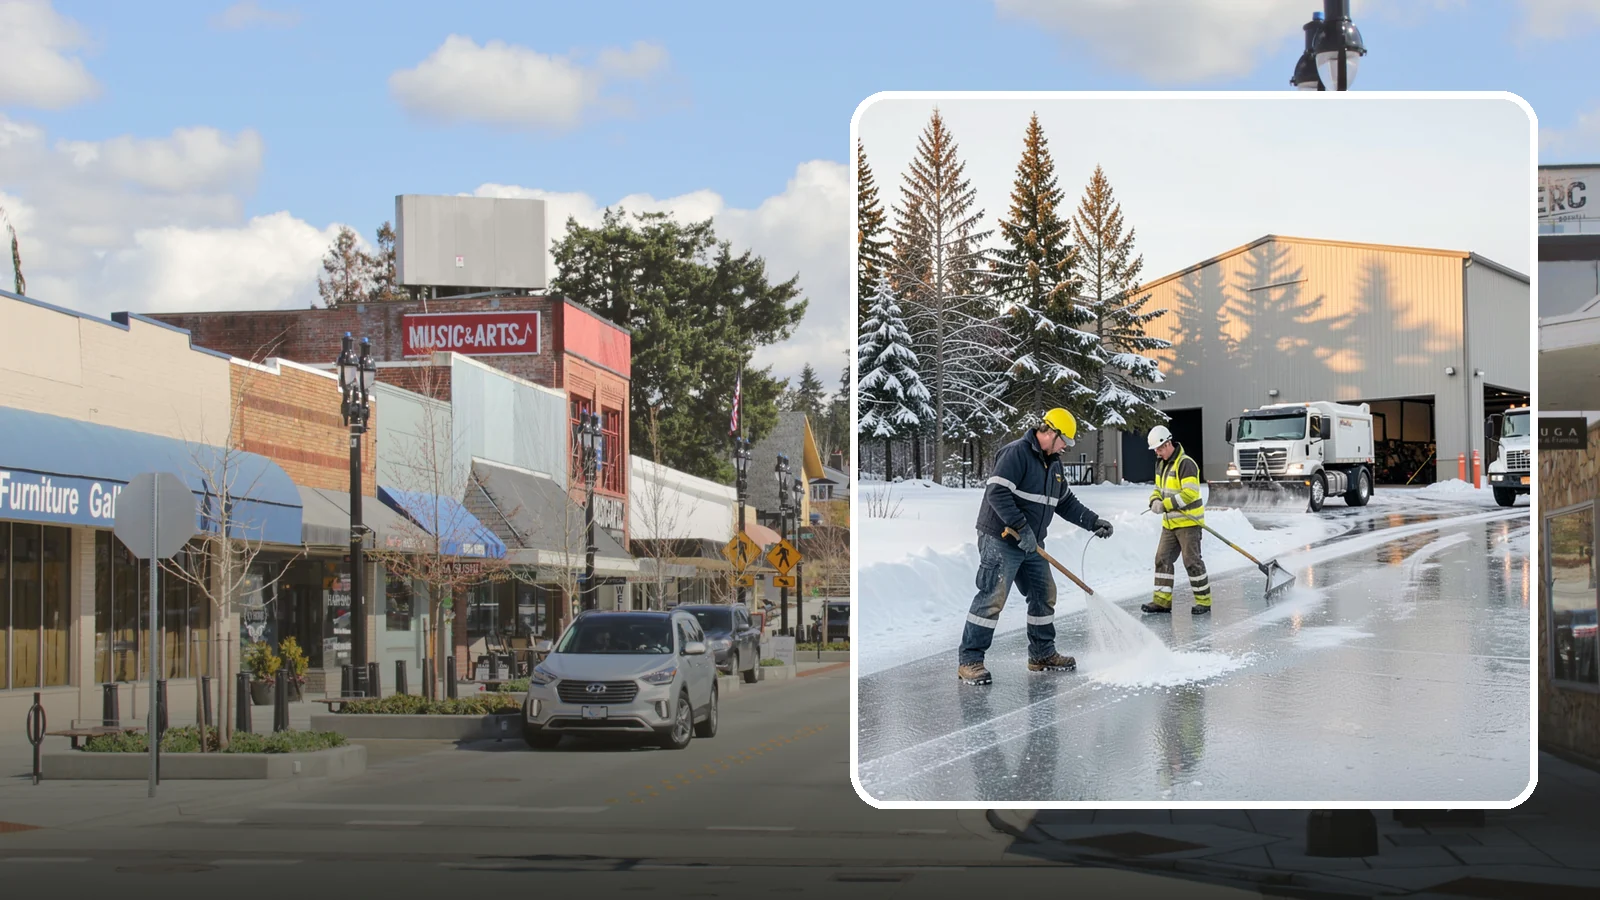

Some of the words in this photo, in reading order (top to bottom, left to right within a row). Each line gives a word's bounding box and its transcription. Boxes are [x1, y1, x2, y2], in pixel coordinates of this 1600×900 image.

[409, 322, 520, 349] MUSIC&ARTS
[1540, 427, 1578, 436] UGA
[1551, 436, 1579, 444] Framing
[0, 471, 79, 515] Furniture
[453, 563, 479, 574] SUSHI
